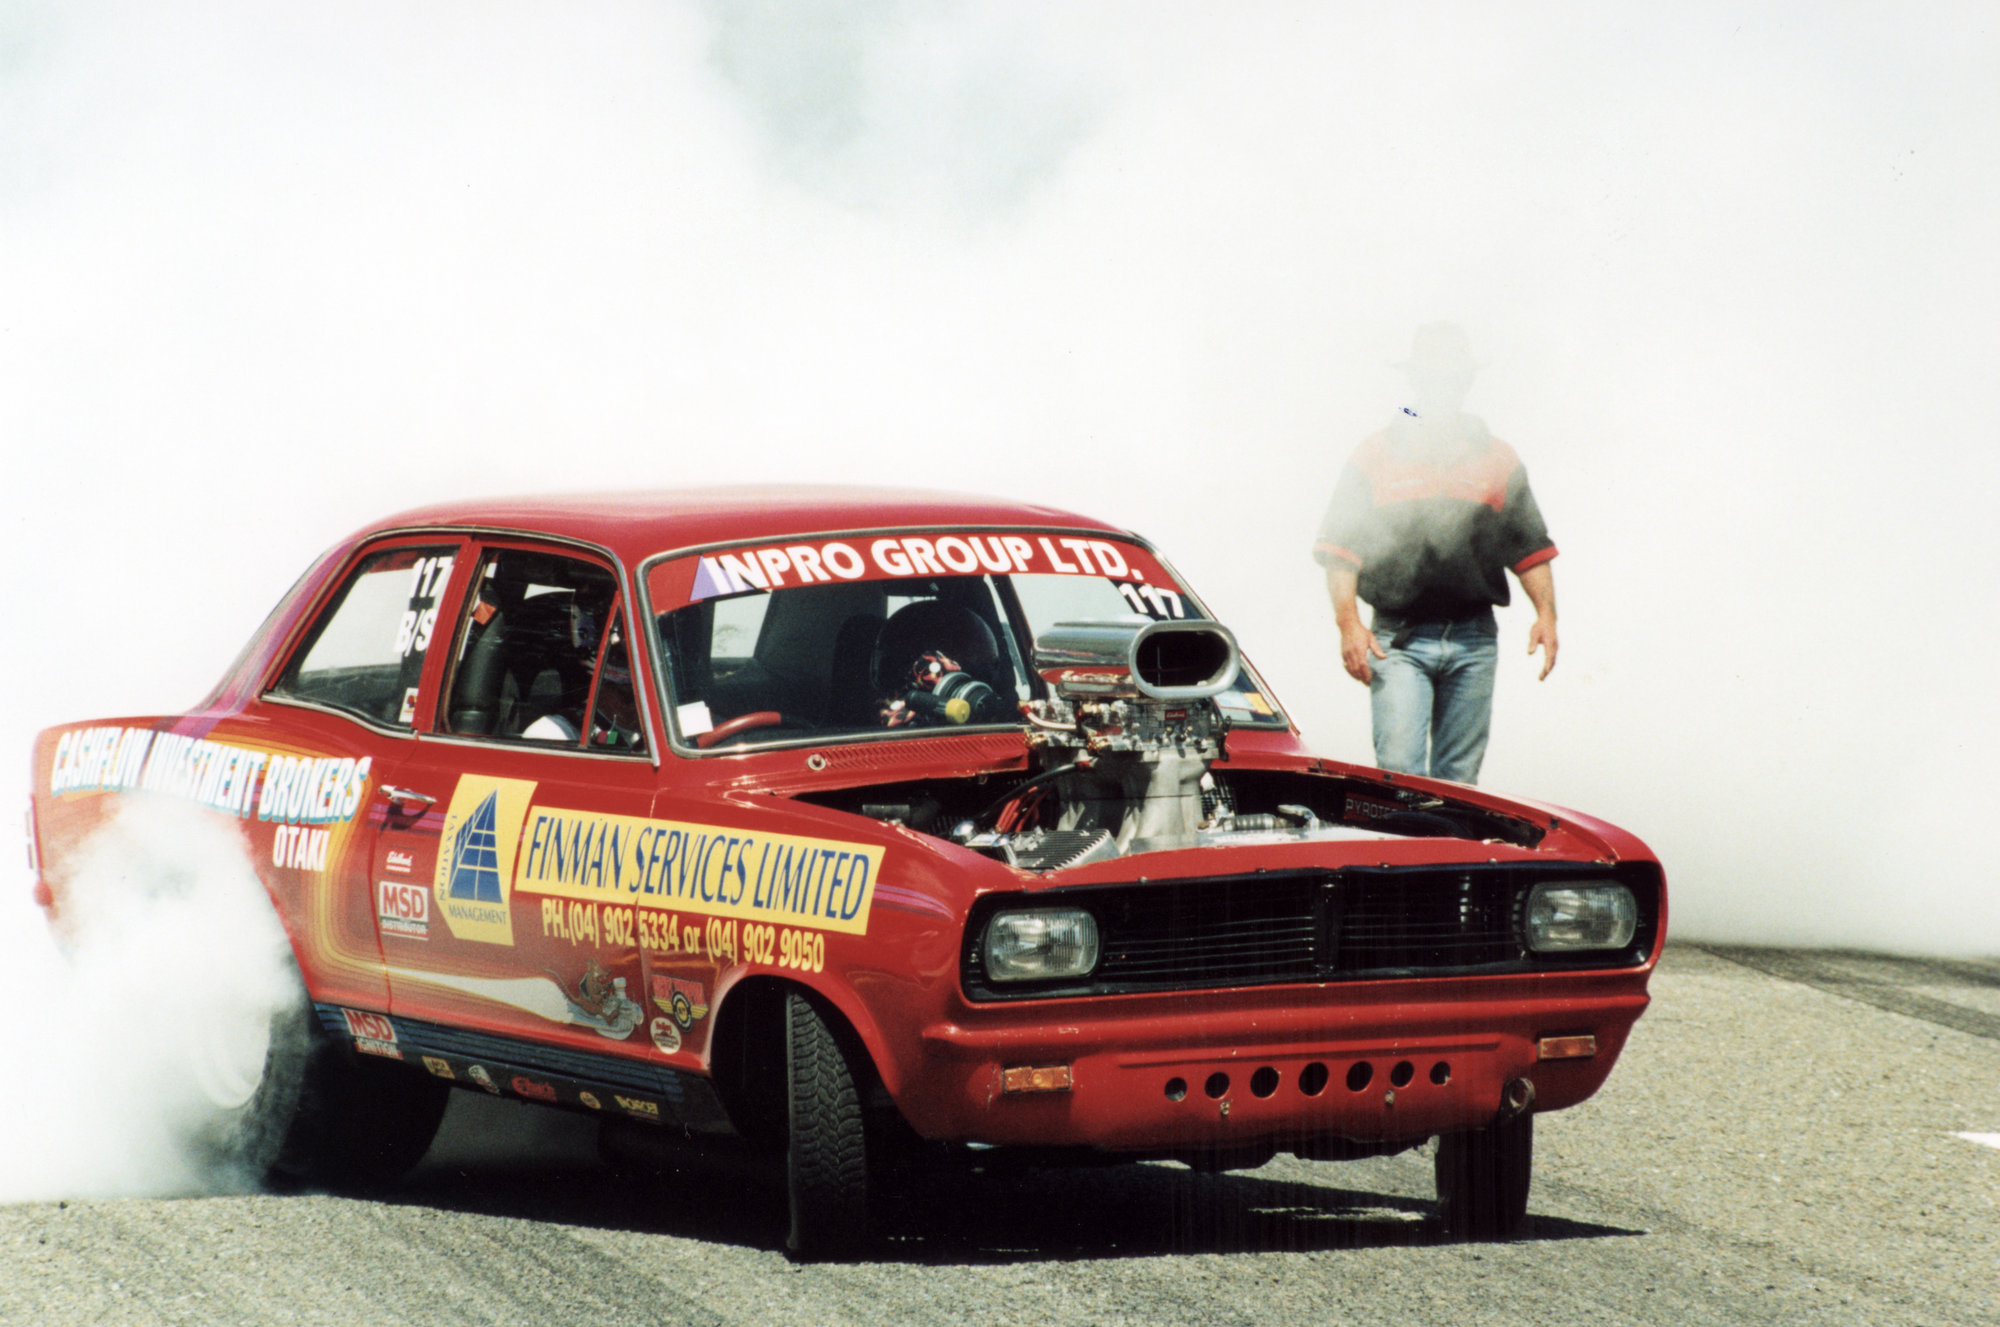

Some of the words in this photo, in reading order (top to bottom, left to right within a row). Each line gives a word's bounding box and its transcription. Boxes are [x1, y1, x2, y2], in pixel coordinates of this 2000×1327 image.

[408, 556, 453, 598] 117
[702, 541, 866, 596] INPRO
[870, 536, 1034, 577] GROUP
[1038, 537, 1145, 580] LTD.
[1117, 581, 1186, 619] 117
[51, 727, 154, 798] CASHFLOW
[141, 731, 267, 818] INVESTMENT
[258, 756, 373, 824] BROKERS
[273, 825, 330, 872] OTAKI
[526, 816, 631, 890] FINMAN
[629, 826, 753, 906] SERVICES
[753, 842, 870, 921] LIMITED
[383, 885, 425, 919] MSD
[449, 904, 507, 925] MANAGEMENT
[604, 906, 636, 946] 902
[639, 911, 679, 951] 5334
[684, 925, 701, 954] or
[705, 917, 738, 966] (04)
[743, 923, 775, 965] 902
[778, 928, 825, 973] 9050
[343, 1008, 393, 1041] MSD
